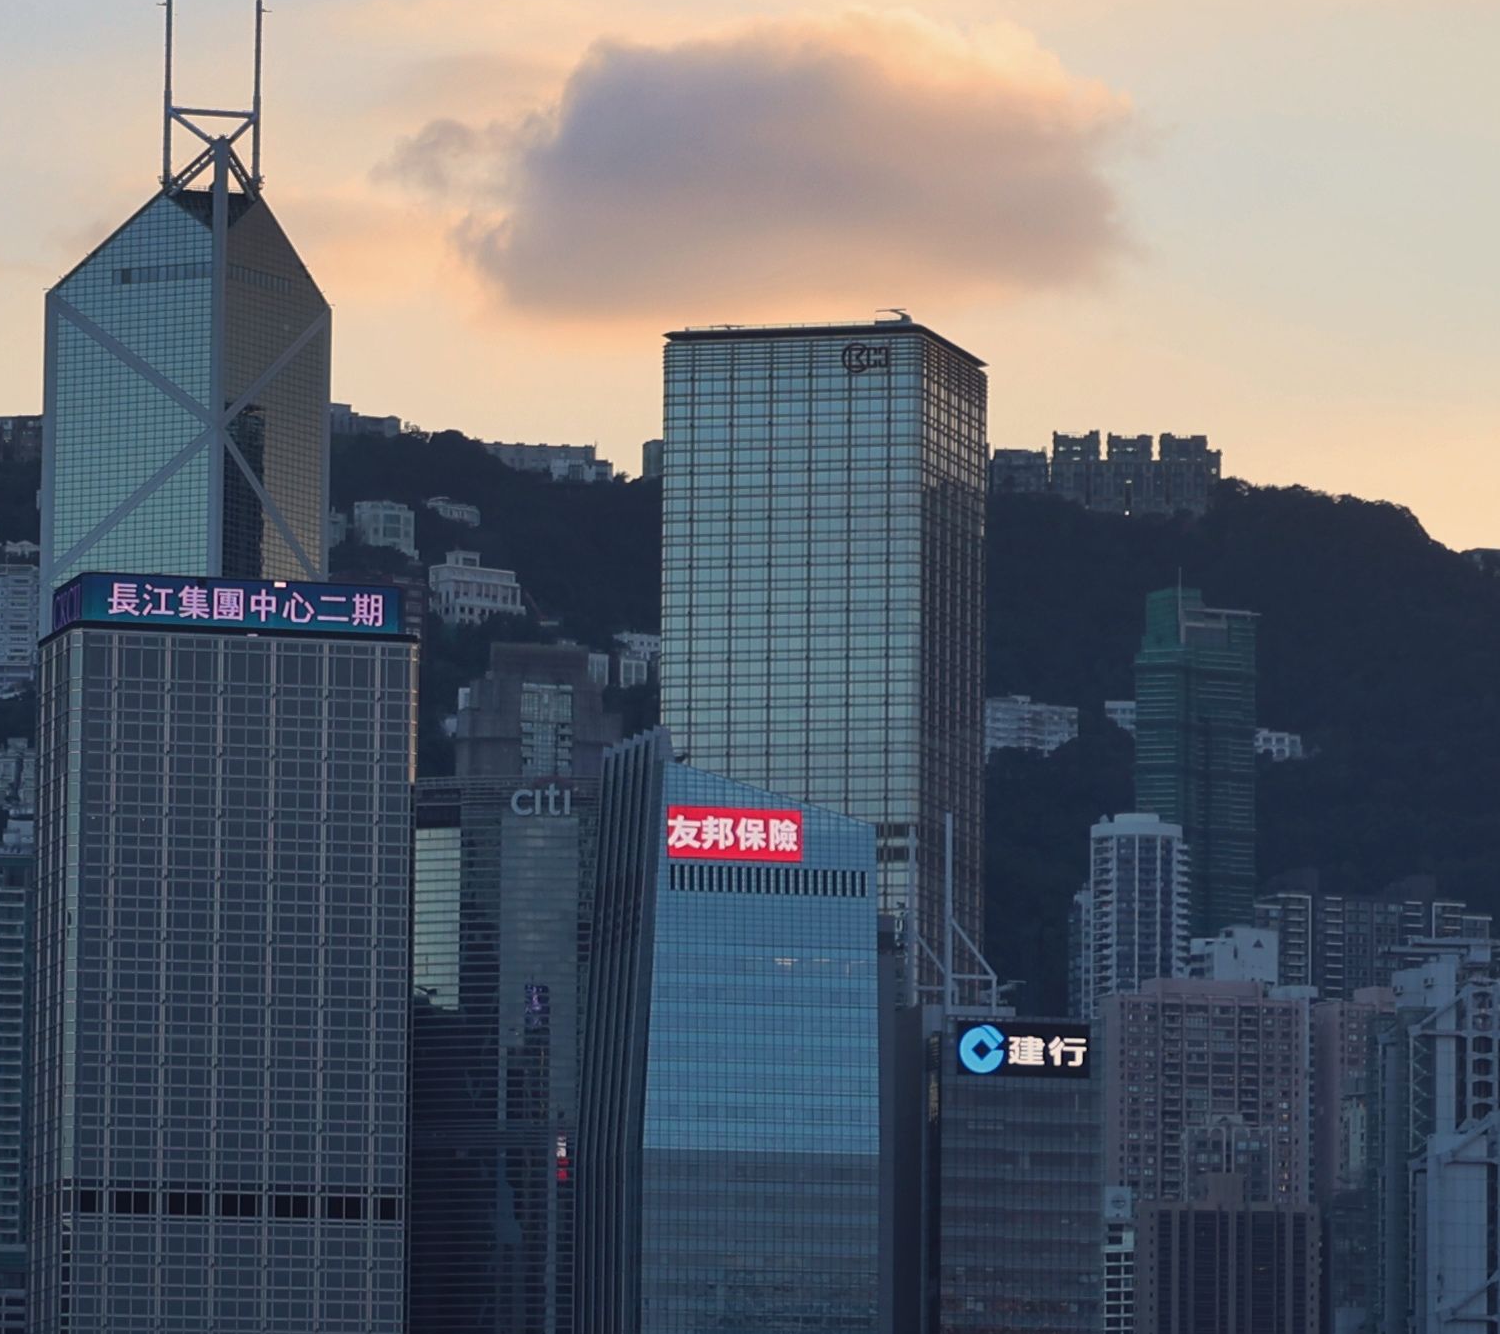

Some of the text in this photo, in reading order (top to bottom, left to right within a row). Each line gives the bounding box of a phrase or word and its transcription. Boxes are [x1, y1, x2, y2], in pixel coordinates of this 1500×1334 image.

[107, 582, 385, 627] 長江集團中心二期
[667, 814, 799, 853] 友邦保險
[1008, 1035, 1088, 1067] 建行
